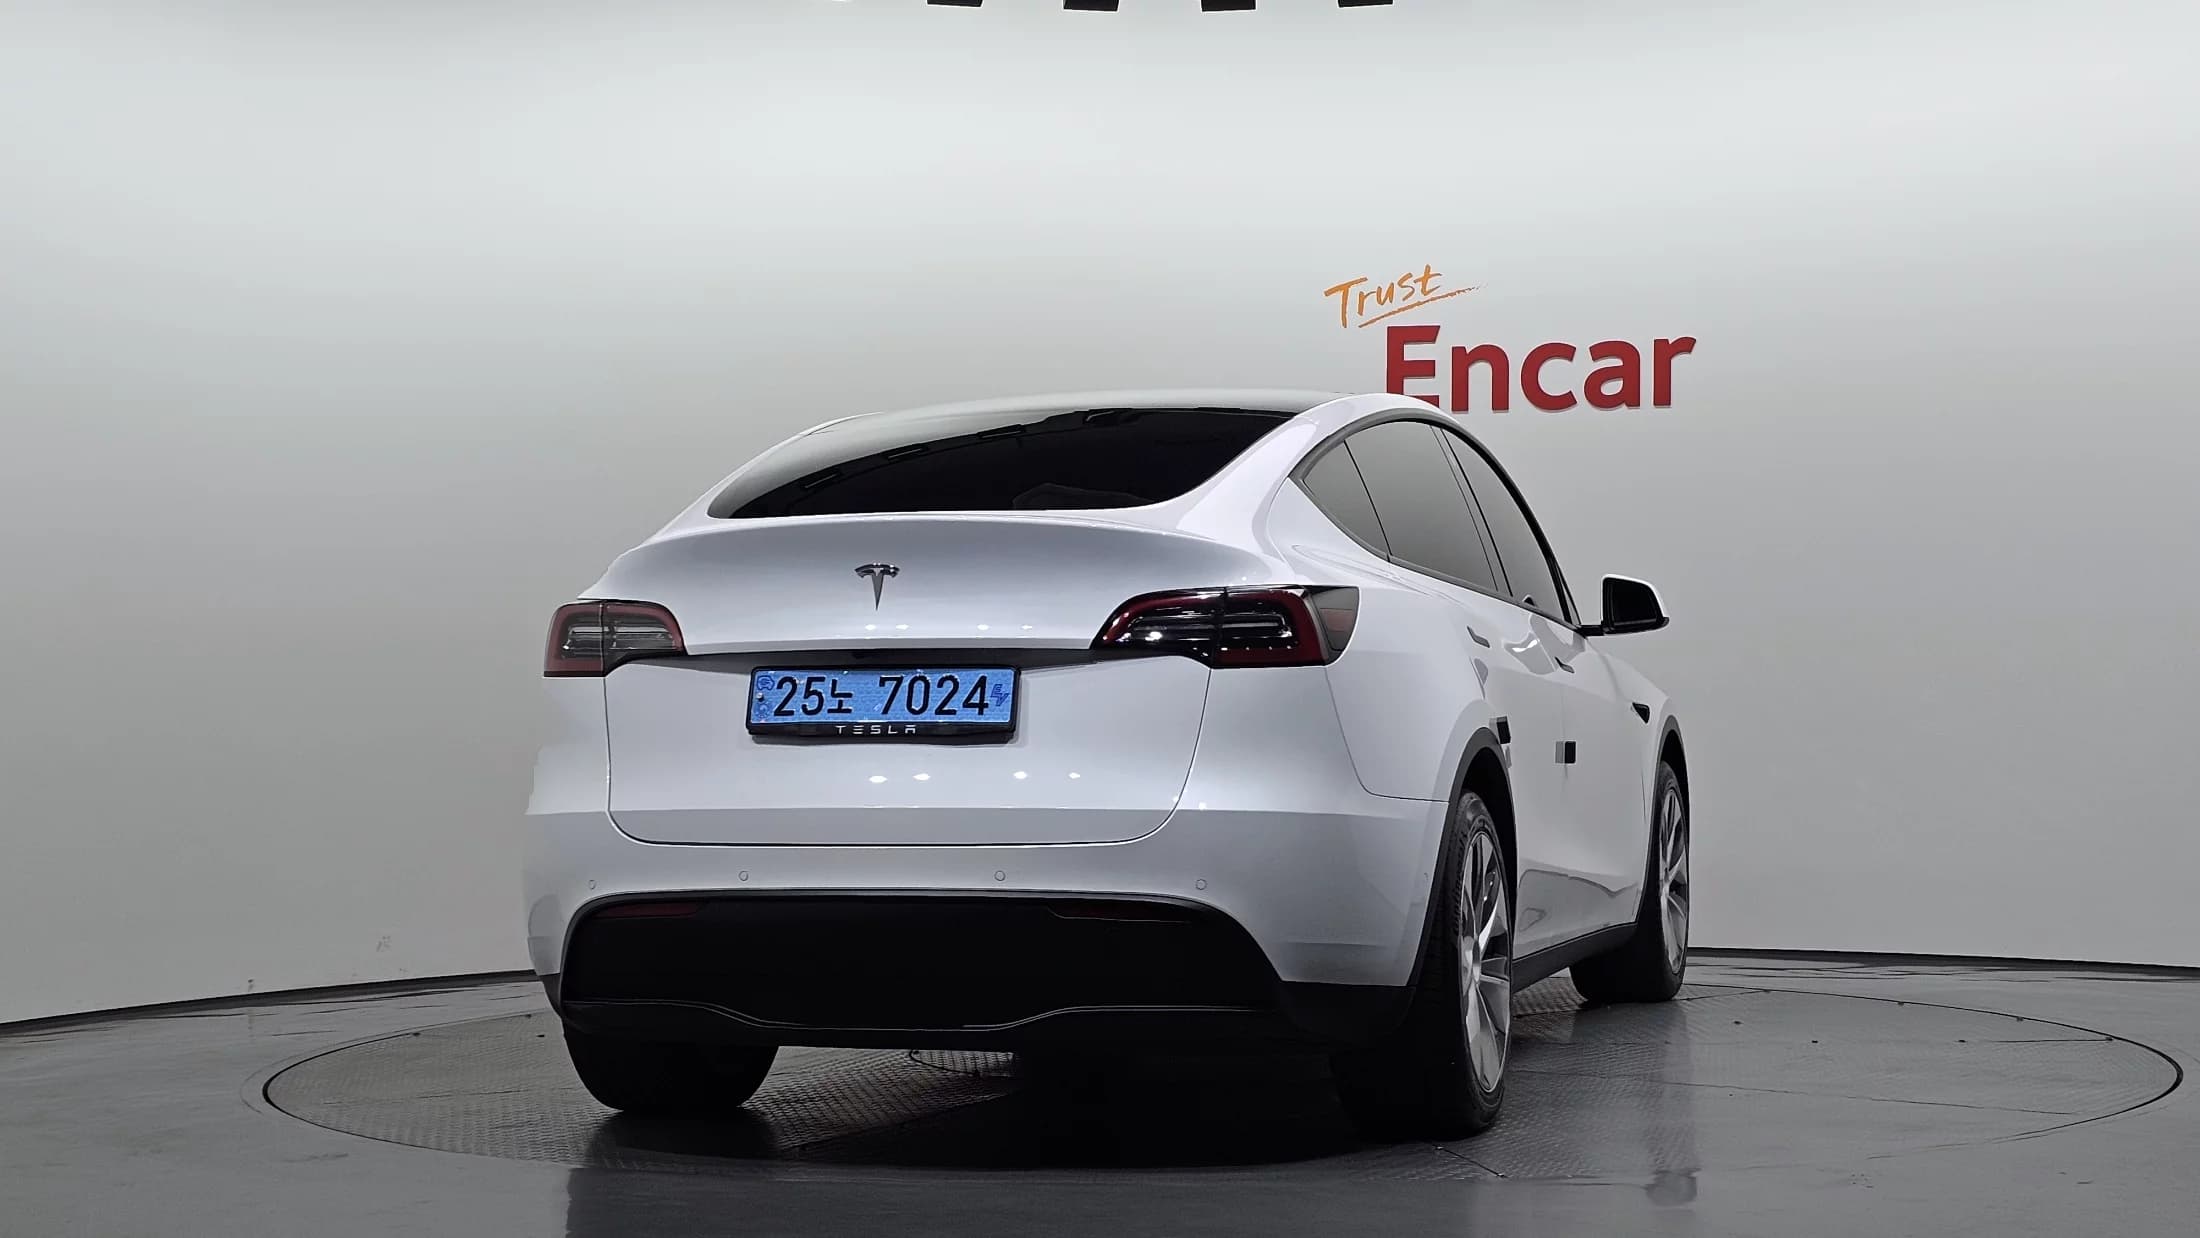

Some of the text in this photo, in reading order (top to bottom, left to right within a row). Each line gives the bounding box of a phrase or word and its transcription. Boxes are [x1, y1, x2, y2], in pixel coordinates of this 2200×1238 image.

[1324, 264, 1442, 328] Trust
[1386, 325, 1697, 412] Encar
[773, 675, 853, 716] 25노
[879, 675, 989, 716] 7024
[835, 724, 917, 735] TESLA
